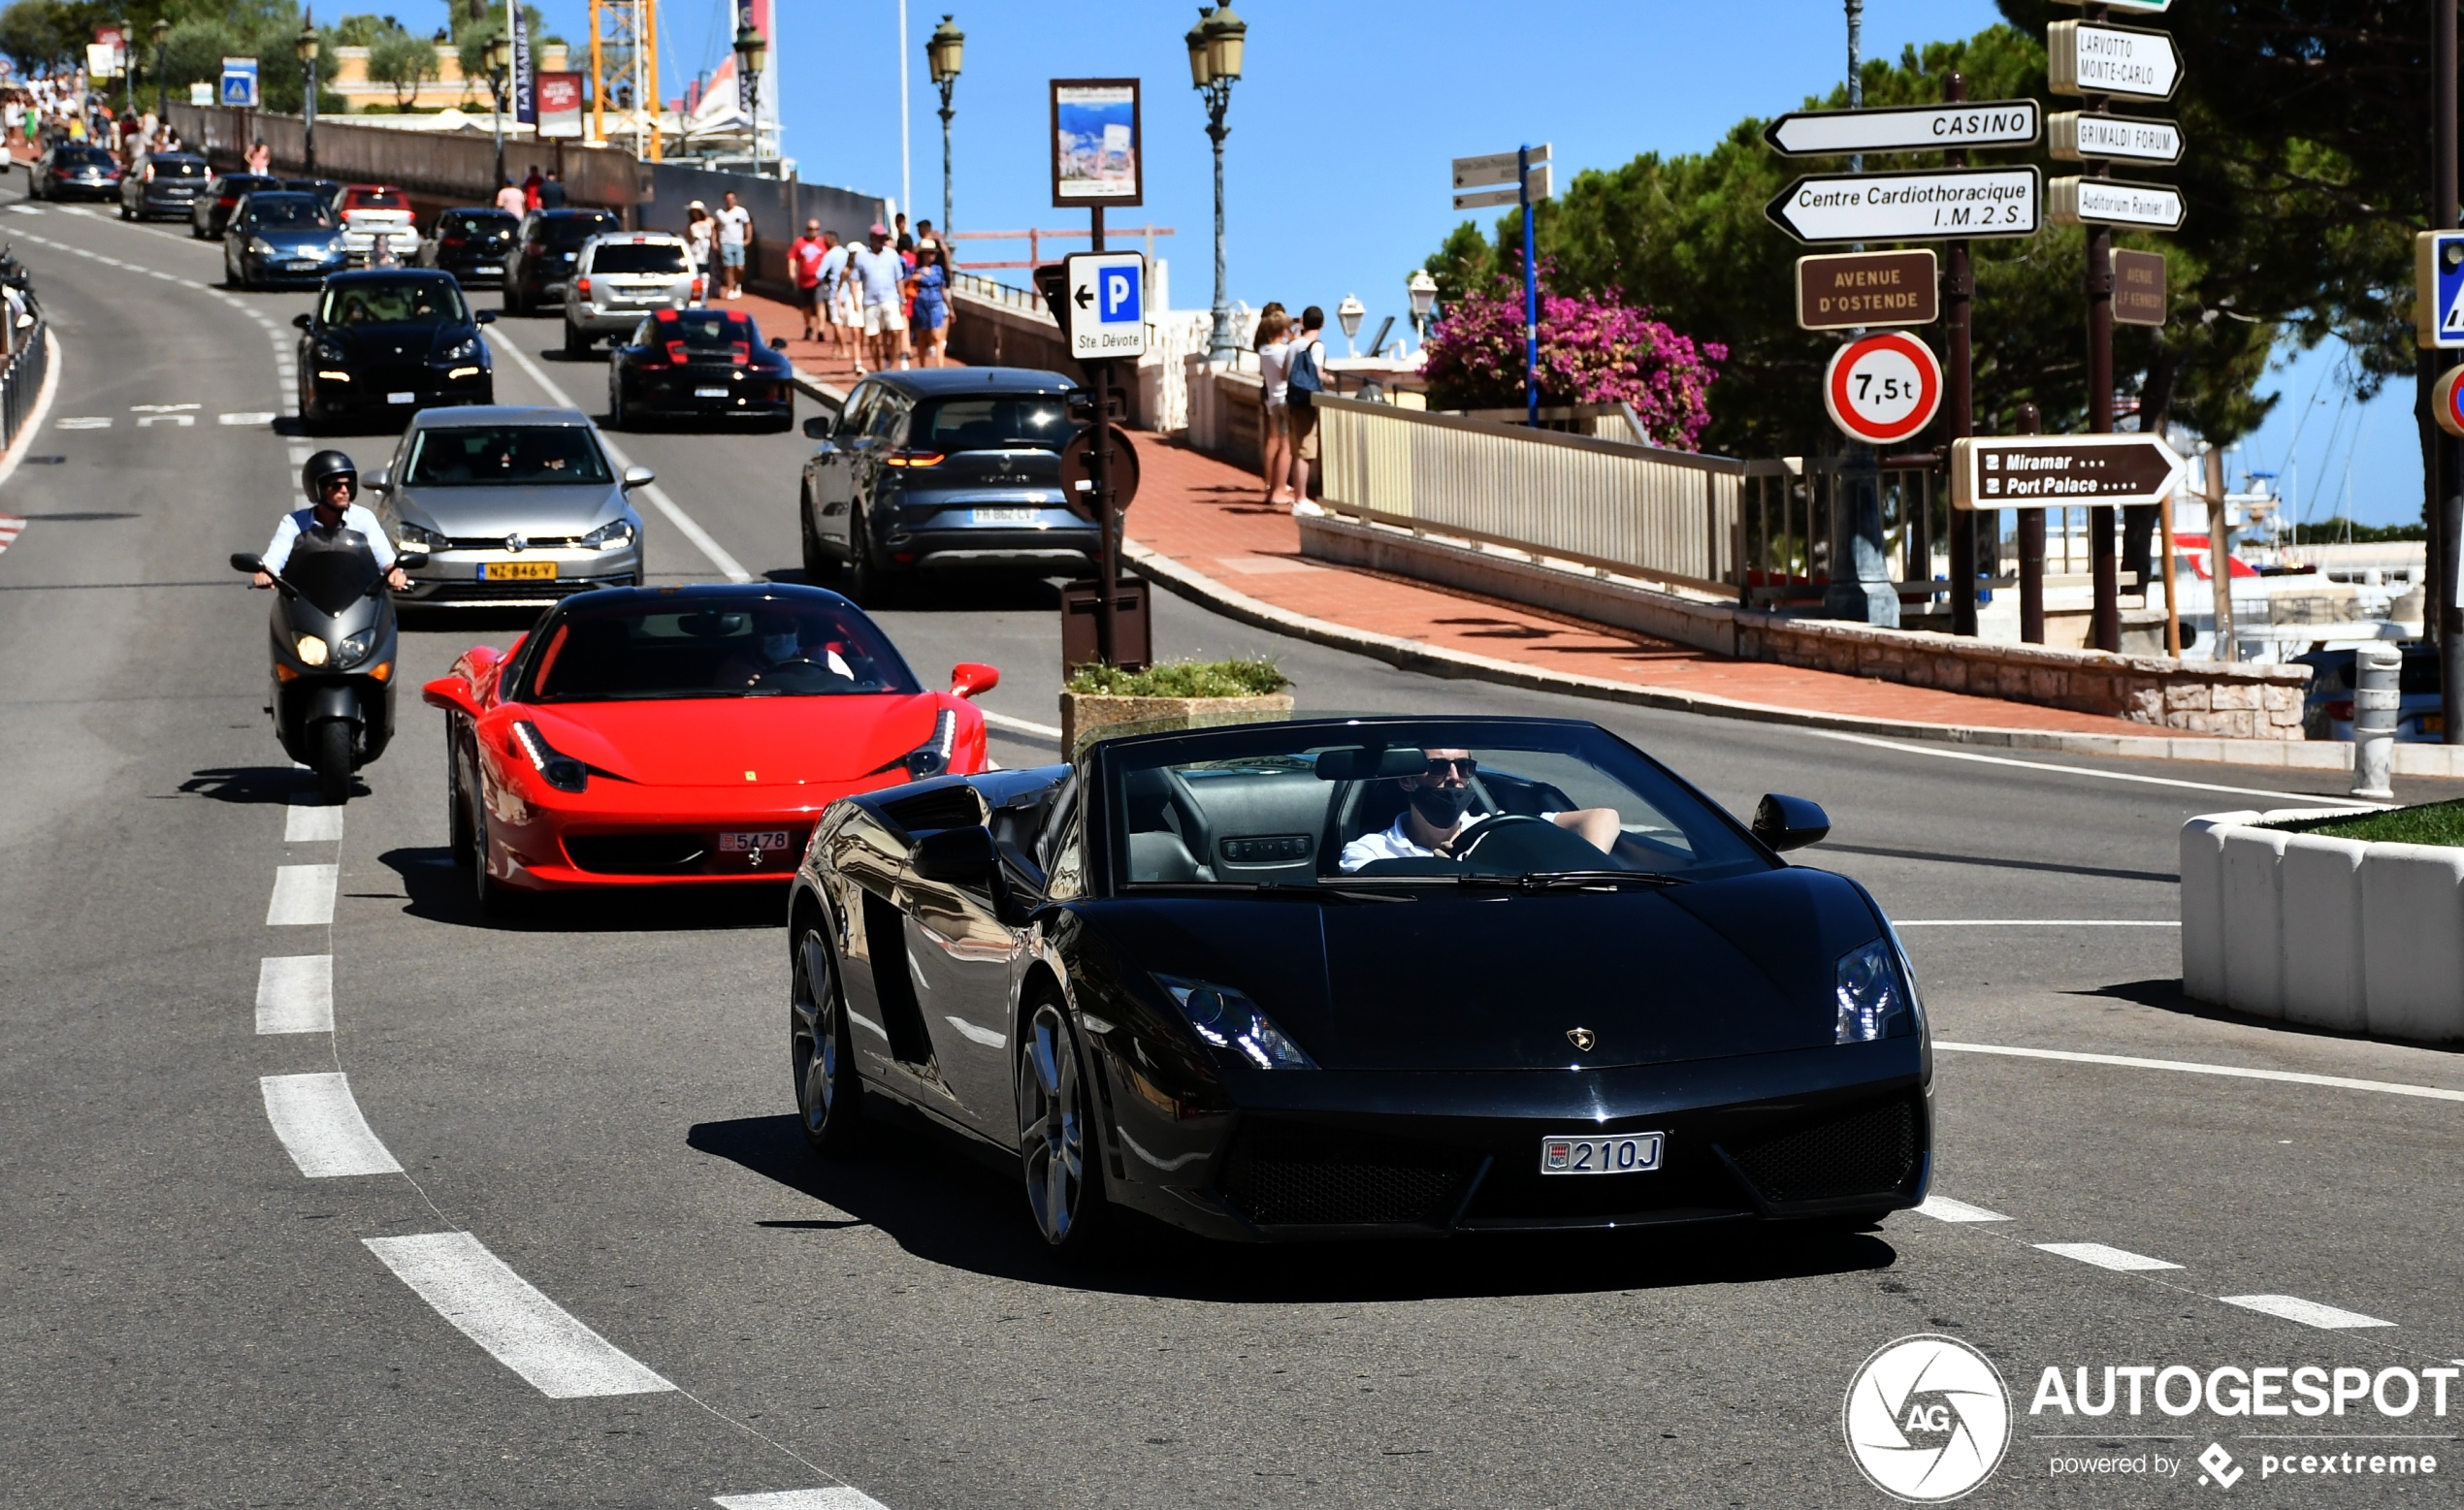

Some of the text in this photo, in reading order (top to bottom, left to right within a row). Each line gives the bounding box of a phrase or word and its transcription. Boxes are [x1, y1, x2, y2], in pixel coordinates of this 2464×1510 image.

[2080, 33, 2132, 58] LARVOTTO
[2081, 58, 2154, 85] MONTE-CARLO
[1932, 112, 2025, 136] CASINO
[2081, 125, 2171, 150] GRIMALDI FORUM
[1799, 182, 2026, 209] Centre Cardiothoracique
[2082, 191, 2129, 213] Auditorium
[2132, 196, 2162, 216] Rainier
[1934, 205, 2026, 227] I.M.2.S.
[1834, 269, 1901, 289] AVENUE
[1108, 274, 1130, 315] P
[1819, 292, 1919, 313] D'OSTENDE
[1102, 333, 1140, 349] Dévote
[2005, 453, 2073, 470] Miramar
[2006, 476, 2098, 495] Port Palace
[737, 832, 786, 850] 5478
[1550, 1156, 1565, 1165] MC
[1572, 1138, 1660, 1171] 210J
